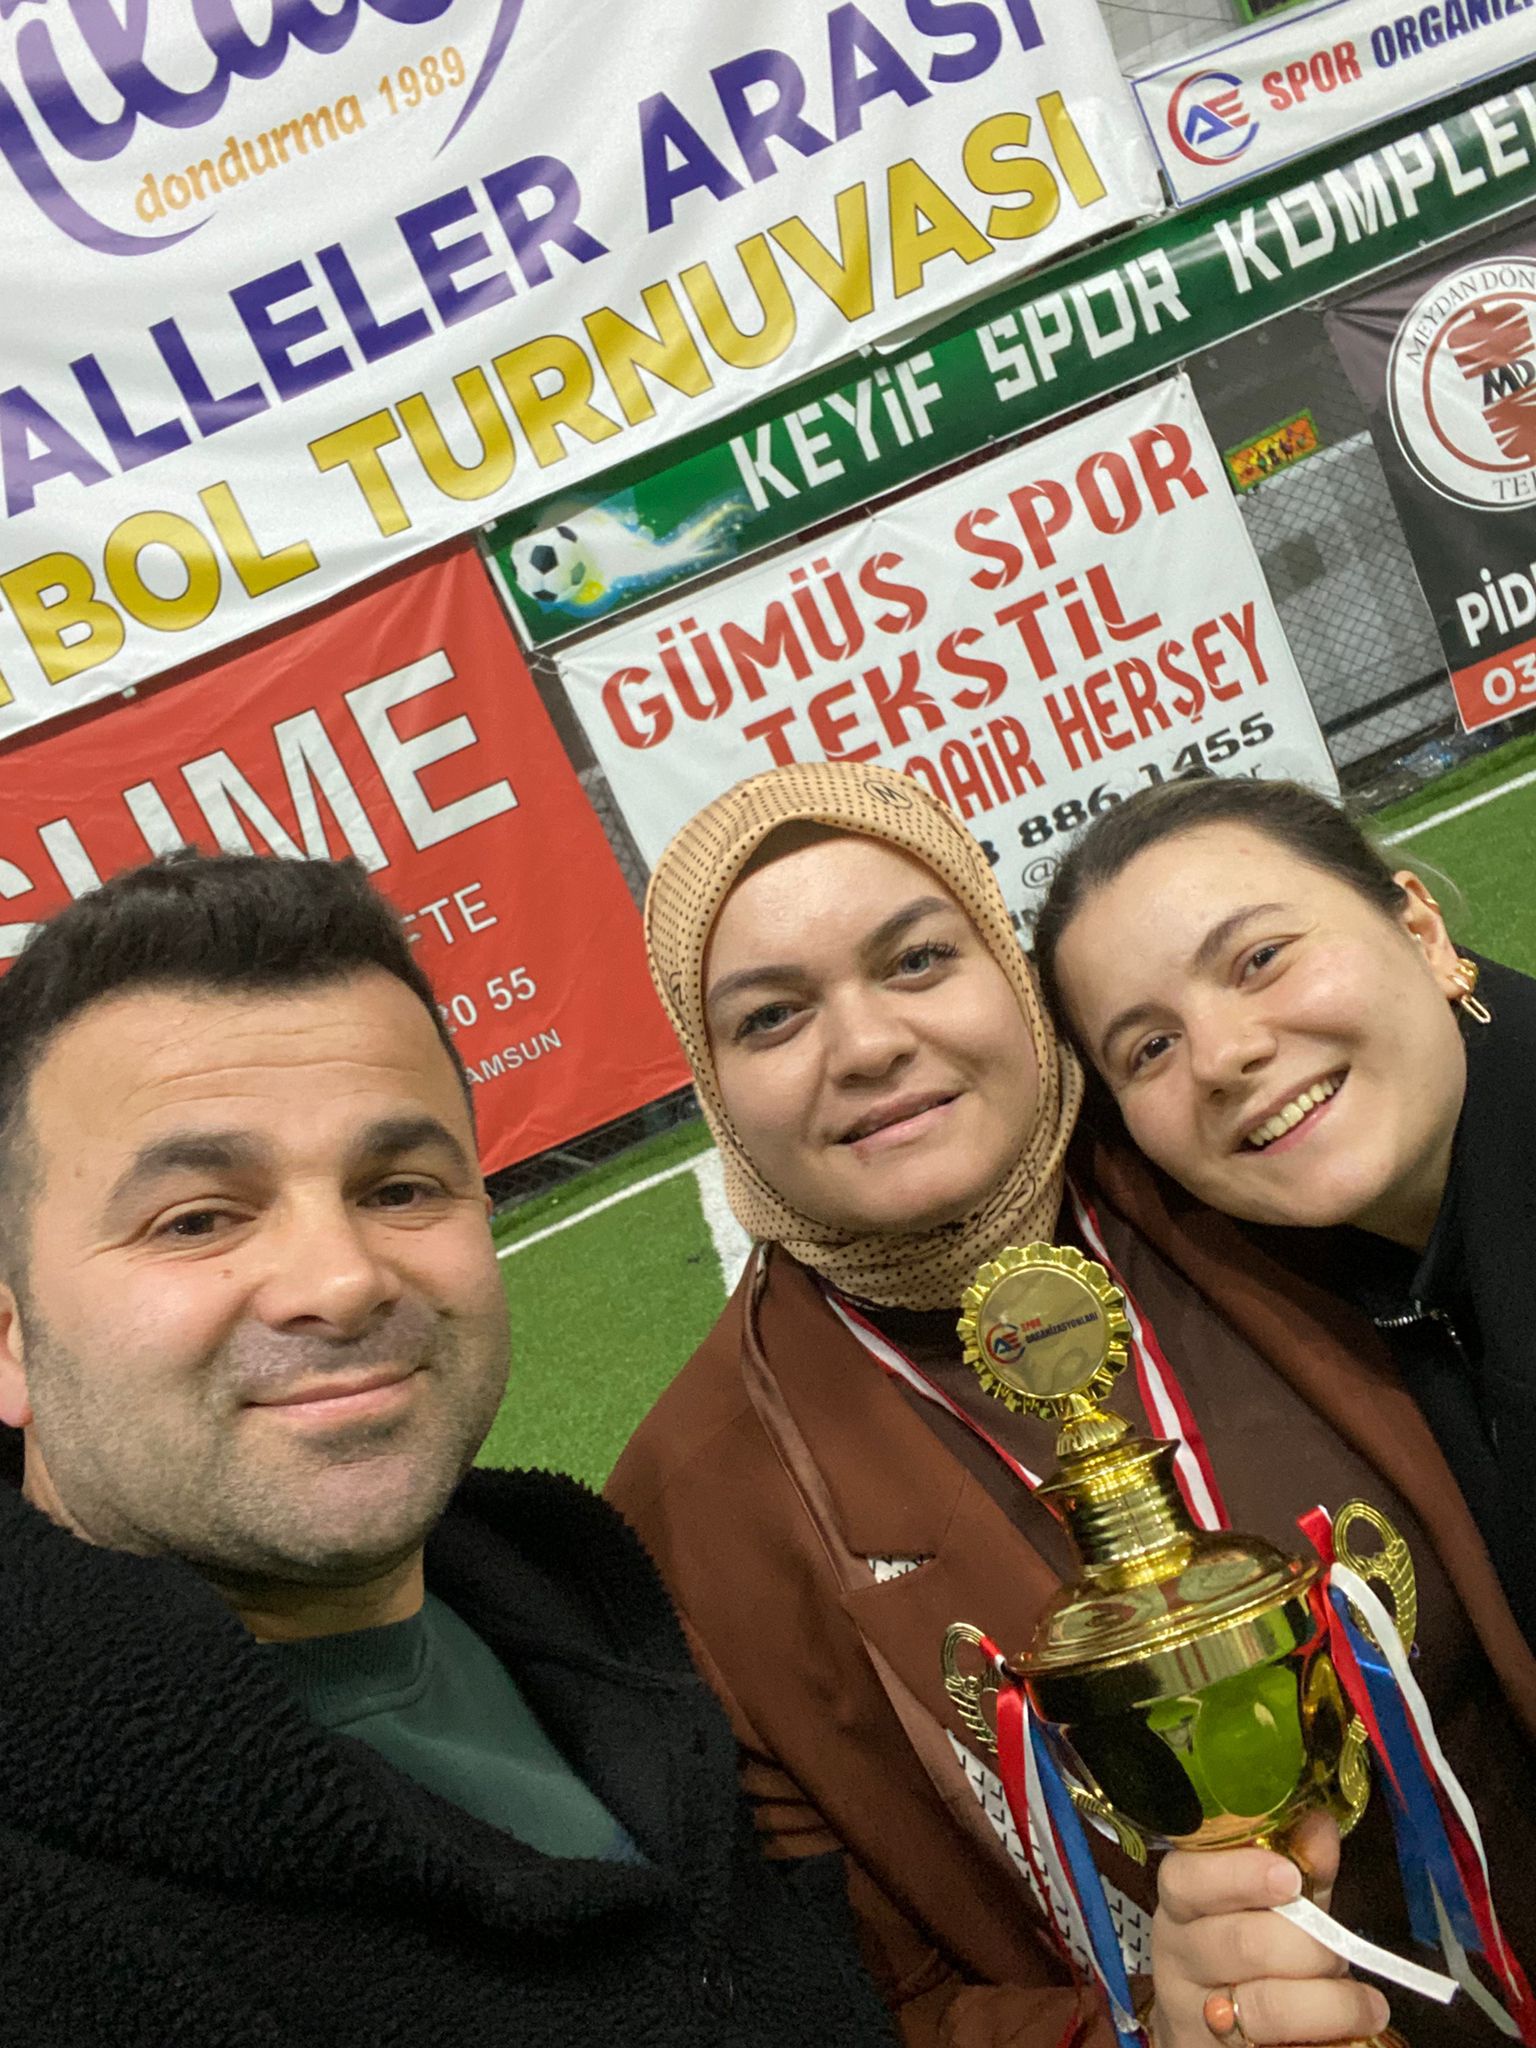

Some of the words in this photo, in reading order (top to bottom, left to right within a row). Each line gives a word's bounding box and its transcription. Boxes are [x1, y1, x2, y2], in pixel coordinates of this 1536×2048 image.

[1261, 40, 1363, 111] SPOR
[134, 94, 367, 223] dondurma
[378, 46, 467, 115] 1989
[1406, 276, 1478, 366] MEYDAN
[0, 480, 320, 708] BOL
[308, 90, 1108, 538] TURNUVASI
[953, 423, 1209, 590] SPOR
[1491, 468, 1536, 501] TE
[1456, 559, 1536, 648] PİD
[1043, 601, 1271, 771] HERŞEY
[486, 966, 537, 1012] 55
